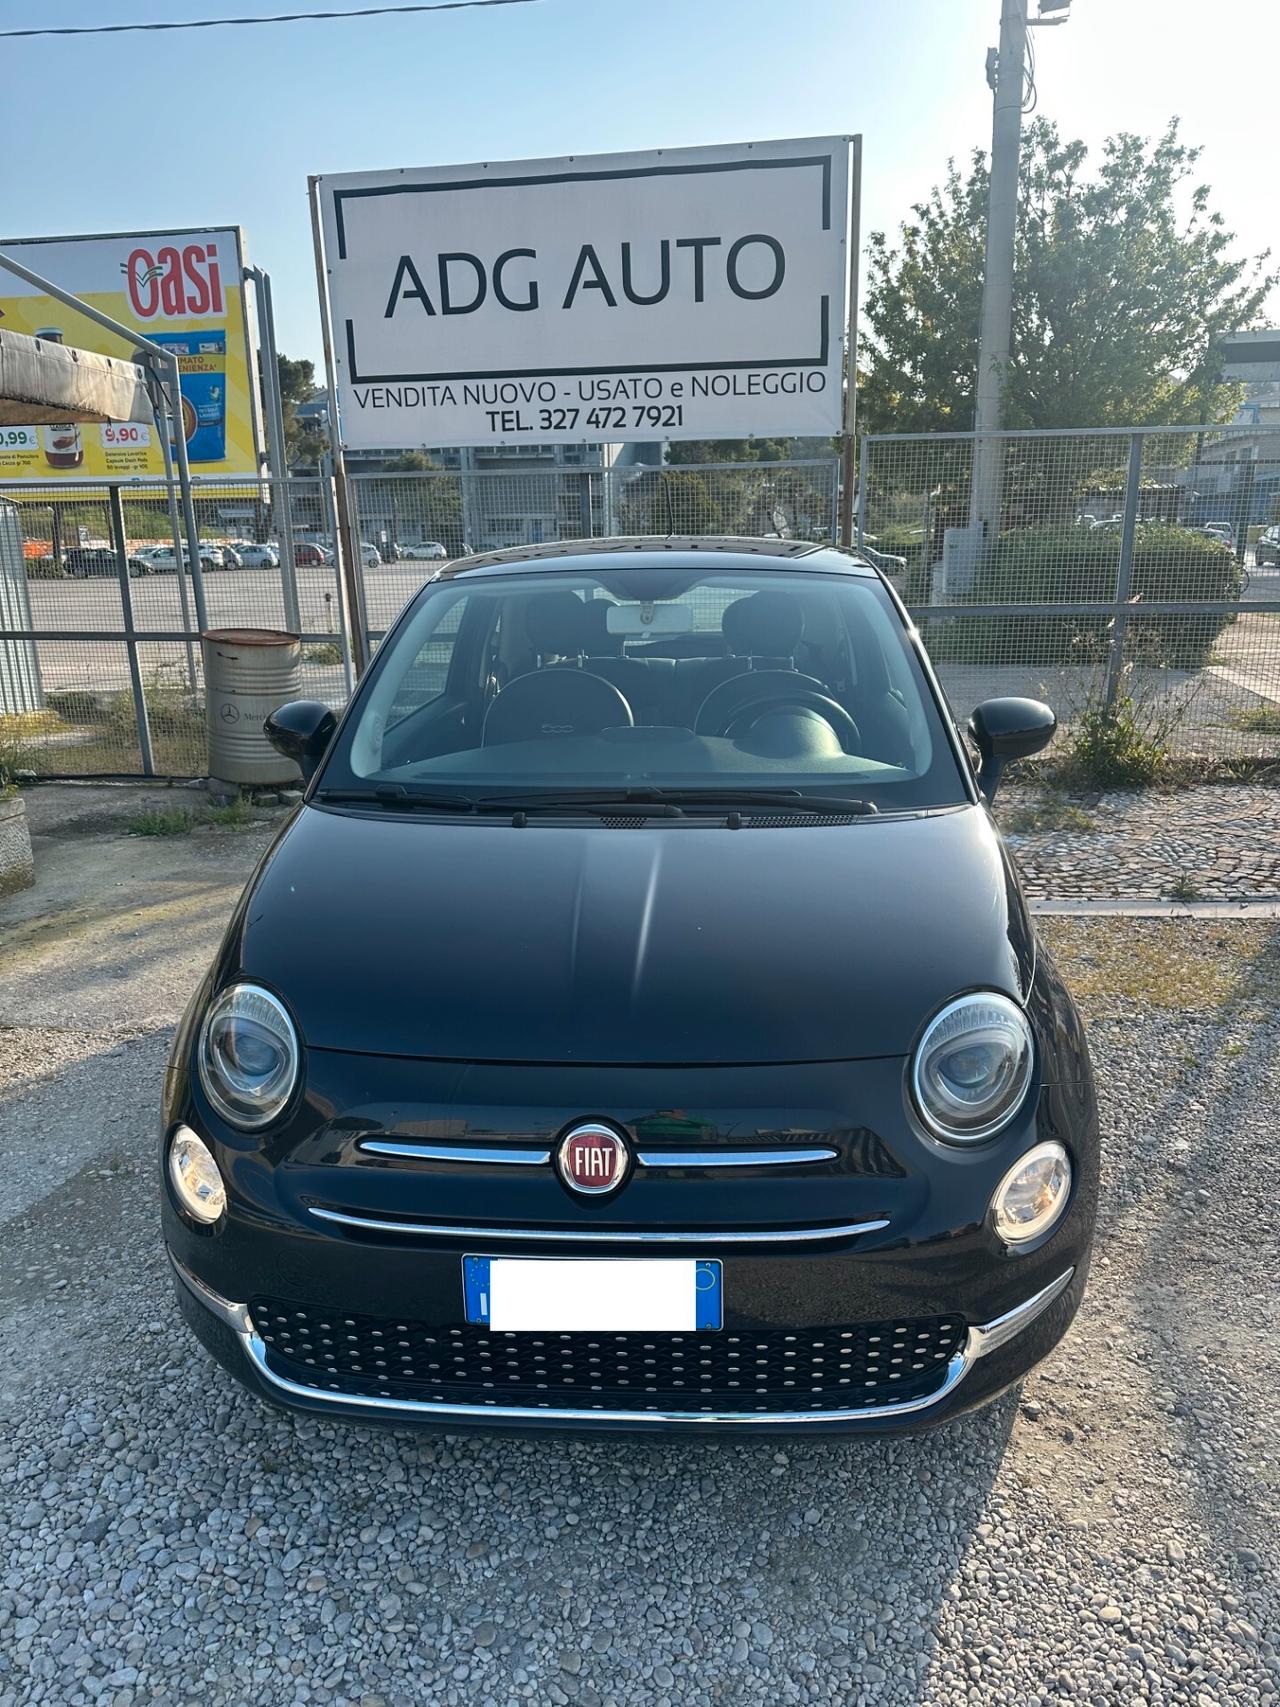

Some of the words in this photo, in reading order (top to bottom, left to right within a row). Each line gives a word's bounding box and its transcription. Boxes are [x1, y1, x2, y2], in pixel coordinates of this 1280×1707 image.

[127, 244, 223, 317] Oasi
[384, 247, 539, 319] ADG
[561, 233, 786, 310] AUTO
[178, 356, 204, 364] MATO
[353, 385, 457, 409] VENDITA
[463, 381, 556, 405] NUOVO
[578, 377, 663, 402] USATO
[670, 382, 684, 398] e
[691, 371, 826, 398] NOLEGGIO
[486, 410, 534, 433] TEL.
[539, 408, 580, 431] 327
[586, 406, 627, 429] 472
[632, 404, 684, 428] 7921
[105, 427, 138, 444] 9,90
[575, 1147, 613, 1177] FIAT
